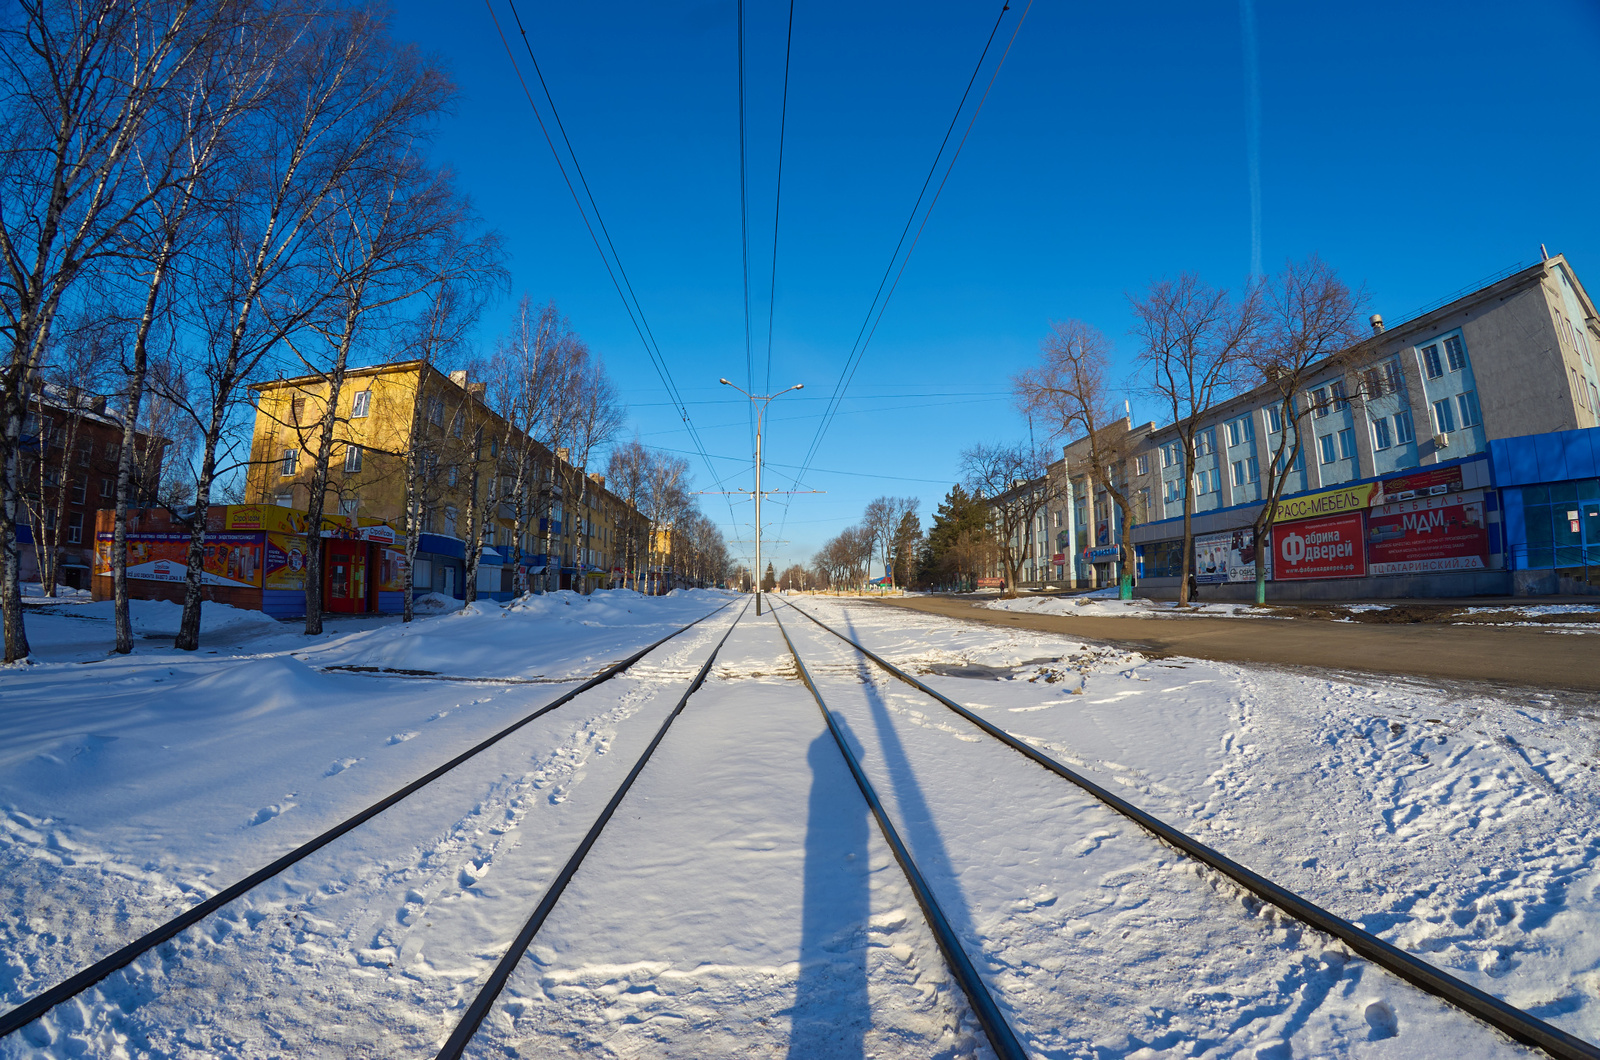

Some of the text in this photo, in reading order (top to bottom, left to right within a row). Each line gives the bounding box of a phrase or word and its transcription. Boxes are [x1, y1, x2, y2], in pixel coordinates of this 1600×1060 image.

[1383, 494, 1463, 514] МЕБЕЛЬ
[1402, 509, 1444, 535] МДМ
[1281, 531, 1340, 566] Фабрика
[1305, 540, 1353, 563] дверей
[1373, 564, 1384, 574] ТЦ
